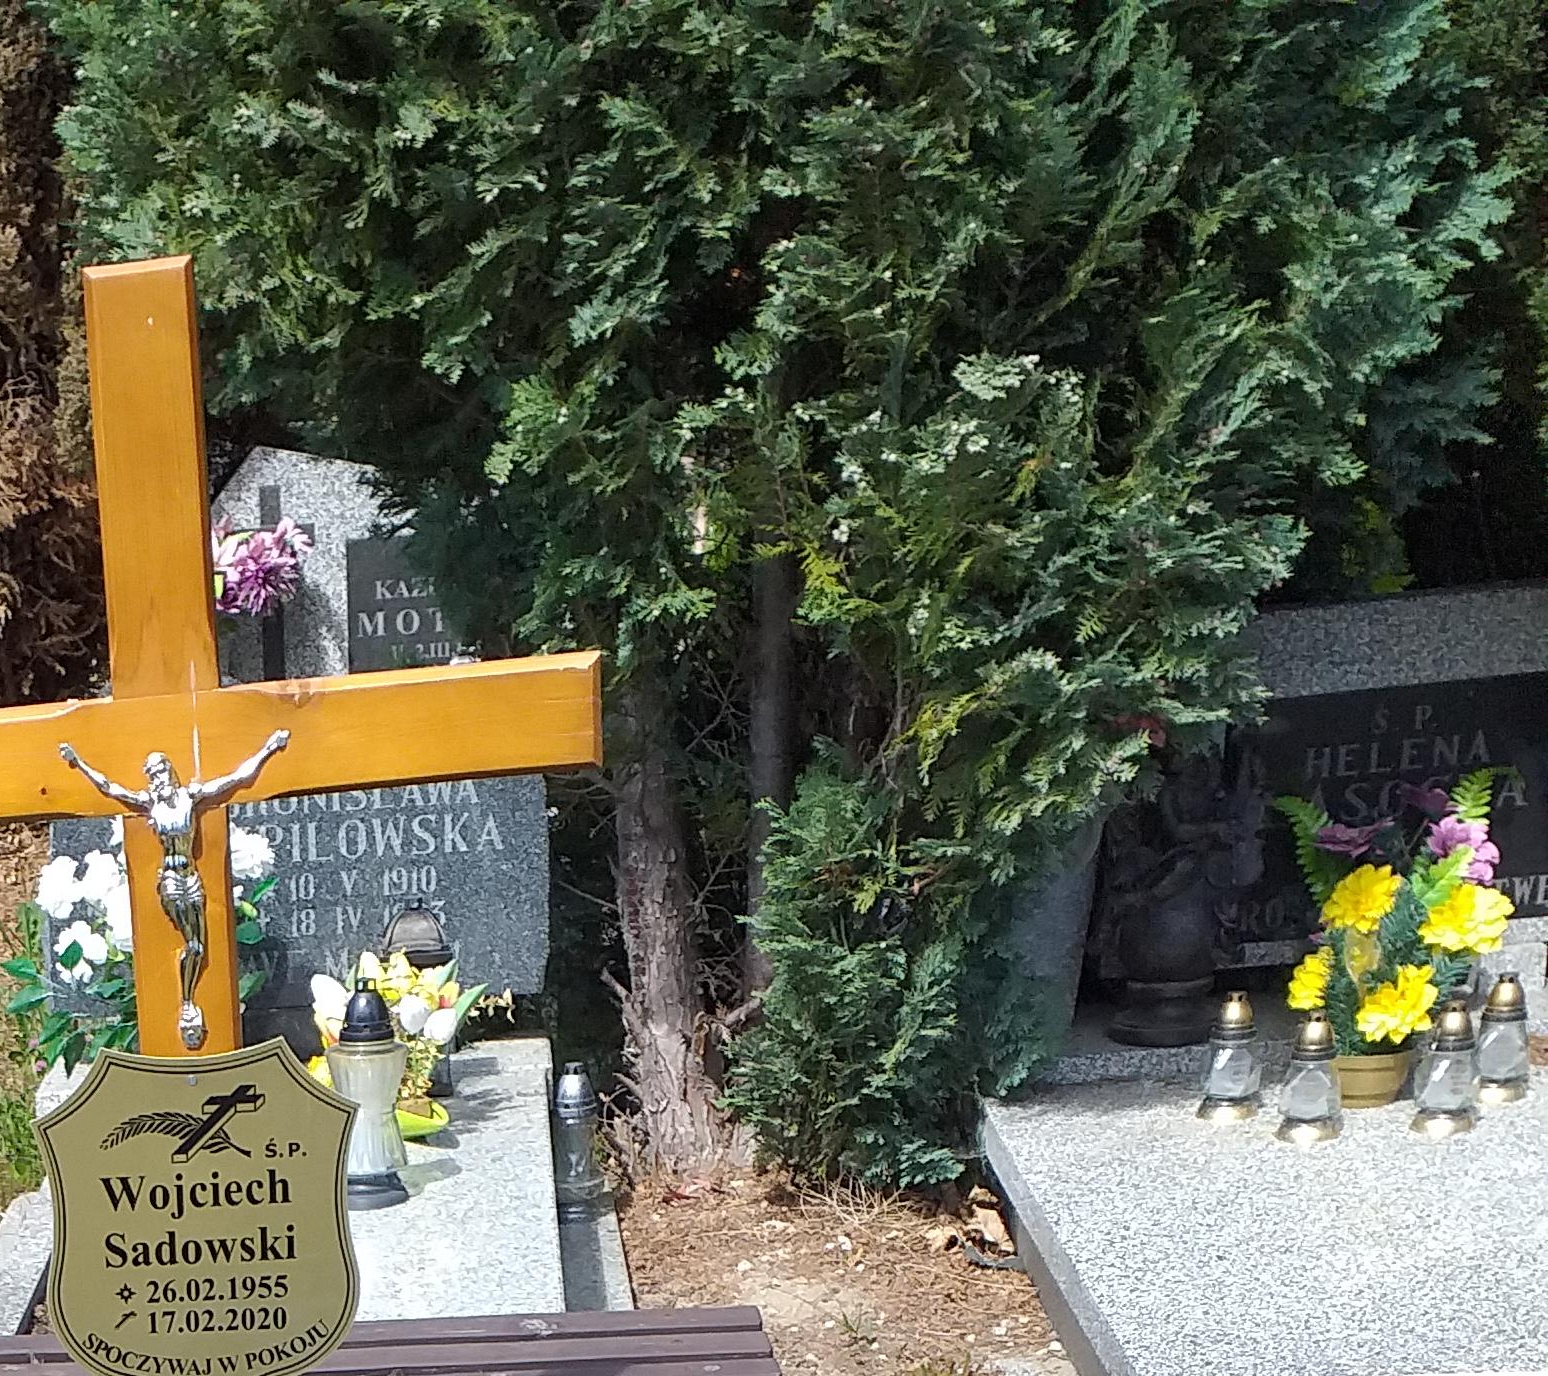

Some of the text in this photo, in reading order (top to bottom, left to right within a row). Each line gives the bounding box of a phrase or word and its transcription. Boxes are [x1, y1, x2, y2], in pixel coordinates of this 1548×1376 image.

[1304, 728, 1492, 780] HELENA
[290, 864, 438, 902] 10 V 1910
[290, 906, 316, 938] 18
[335, 905, 363, 936] IV
[99, 1168, 293, 1220] Wojciech
[105, 1224, 299, 1270] Sadowski
[145, 1274, 290, 1304] 26.02.1955
[146, 1306, 288, 1335] 17.02.2020
[81, 1318, 331, 1376] SPOCZYWAJ W POKOJU
